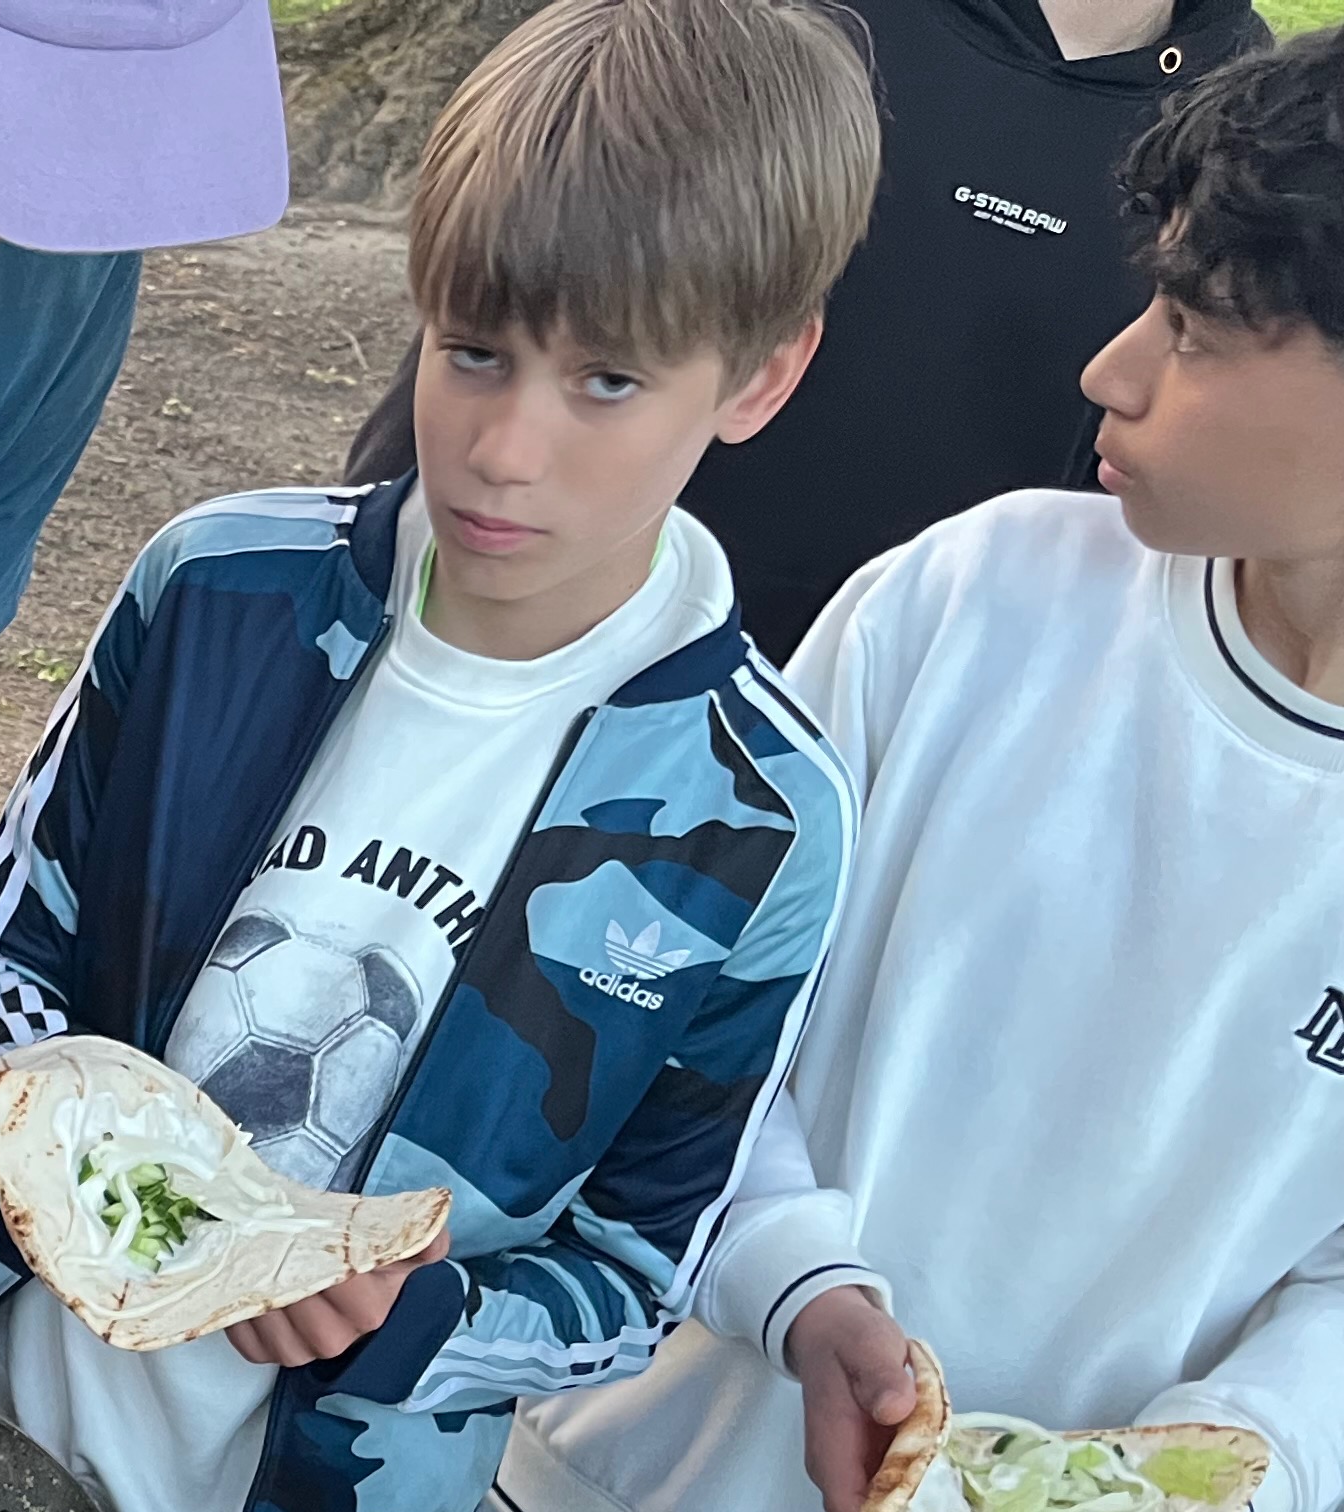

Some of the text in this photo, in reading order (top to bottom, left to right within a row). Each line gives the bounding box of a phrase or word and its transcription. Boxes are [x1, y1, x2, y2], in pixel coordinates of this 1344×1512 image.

[1022, 209, 1067, 235] RAW
[252, 825, 327, 881] AD
[579, 967, 664, 1010] adidas
